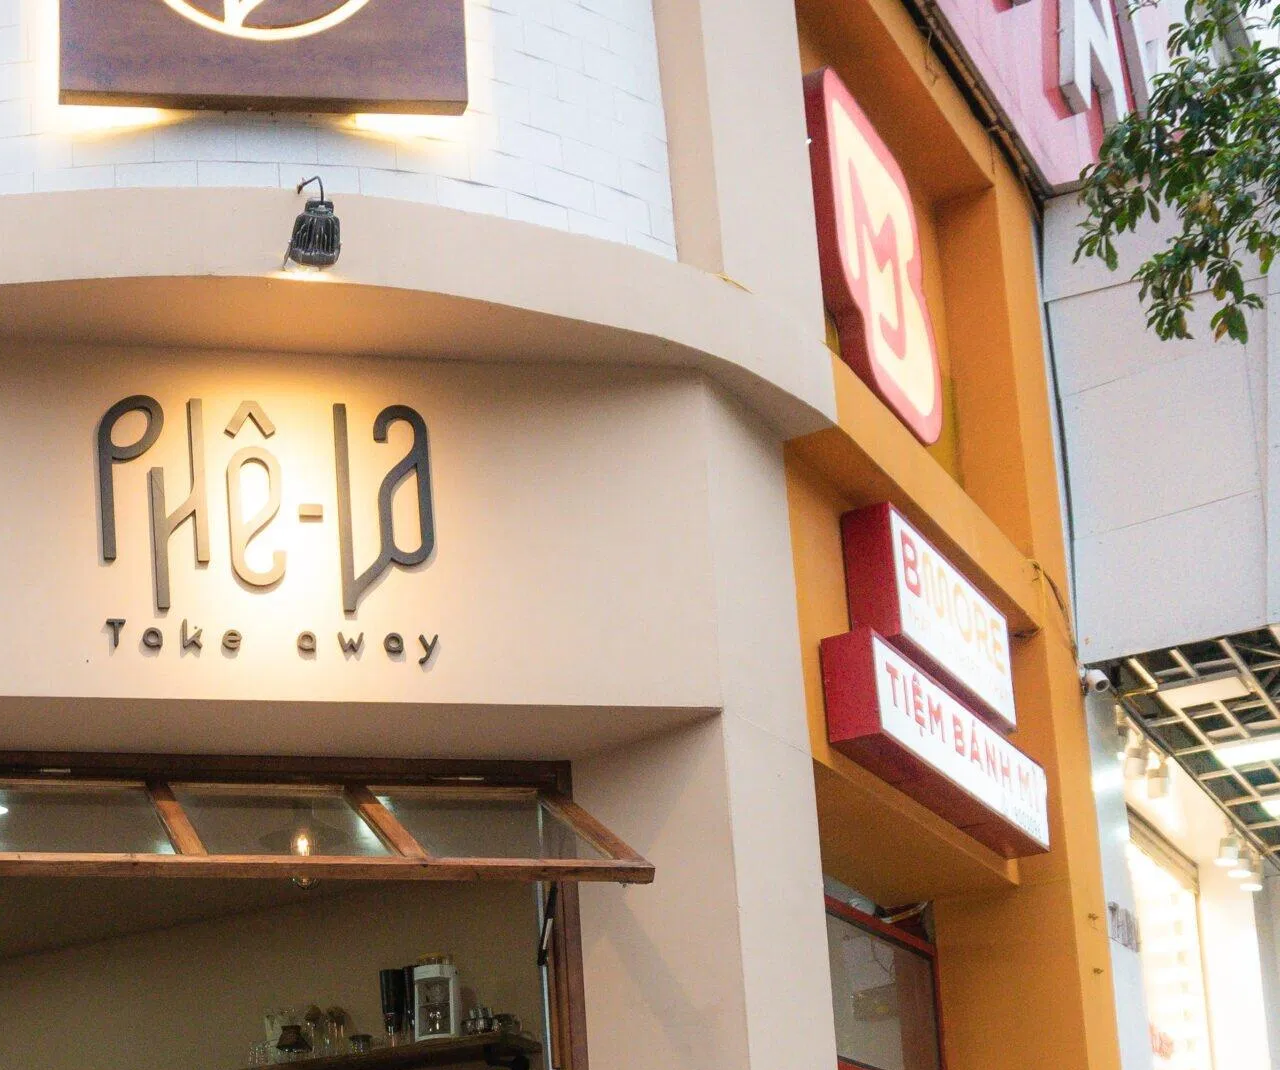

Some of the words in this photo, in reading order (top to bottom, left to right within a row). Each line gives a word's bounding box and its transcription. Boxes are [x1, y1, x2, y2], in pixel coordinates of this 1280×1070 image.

[106, 618, 243, 651] Take
[297, 629, 439, 664] away
[885, 660, 946, 744] TIỆM
[952, 713, 1013, 793] BÁNH
